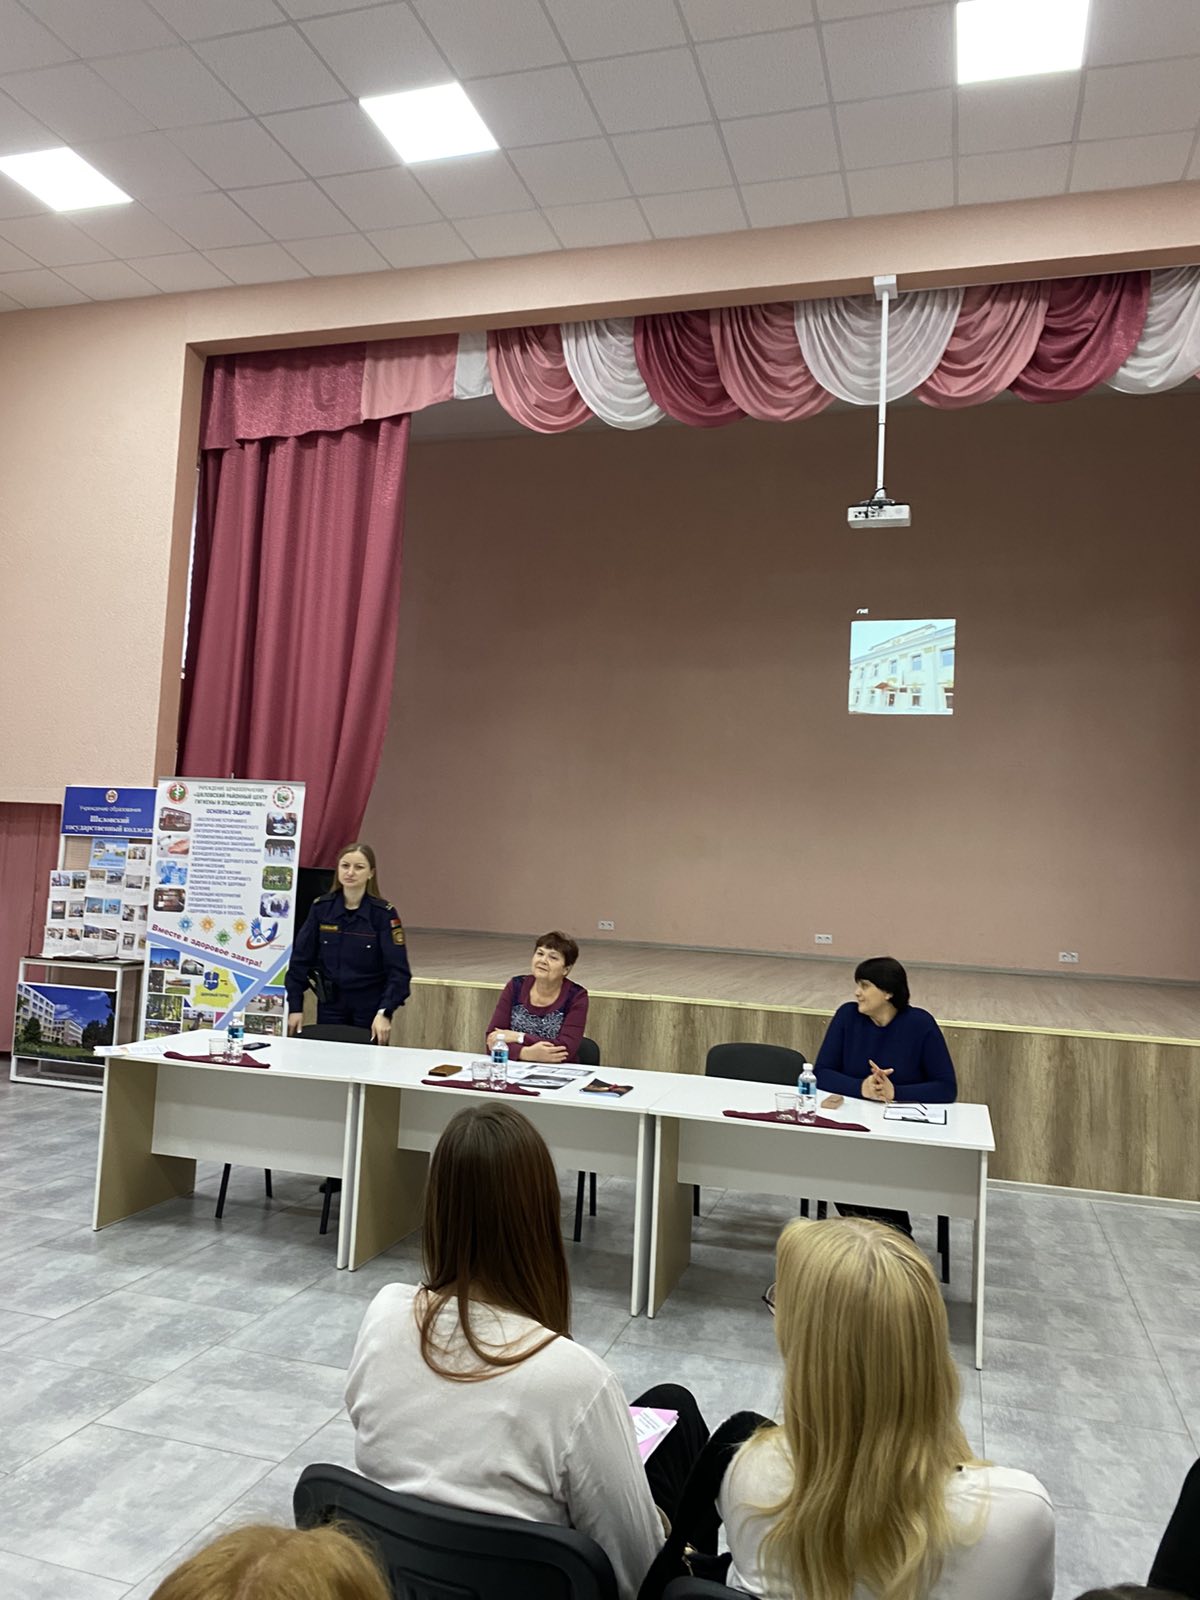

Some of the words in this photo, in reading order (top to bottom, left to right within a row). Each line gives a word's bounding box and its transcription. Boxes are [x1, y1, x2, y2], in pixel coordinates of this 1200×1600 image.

[152, 924, 181, 939] Вместе
[190, 938, 229, 955] здоровое
[231, 952, 262, 967] завтра!
